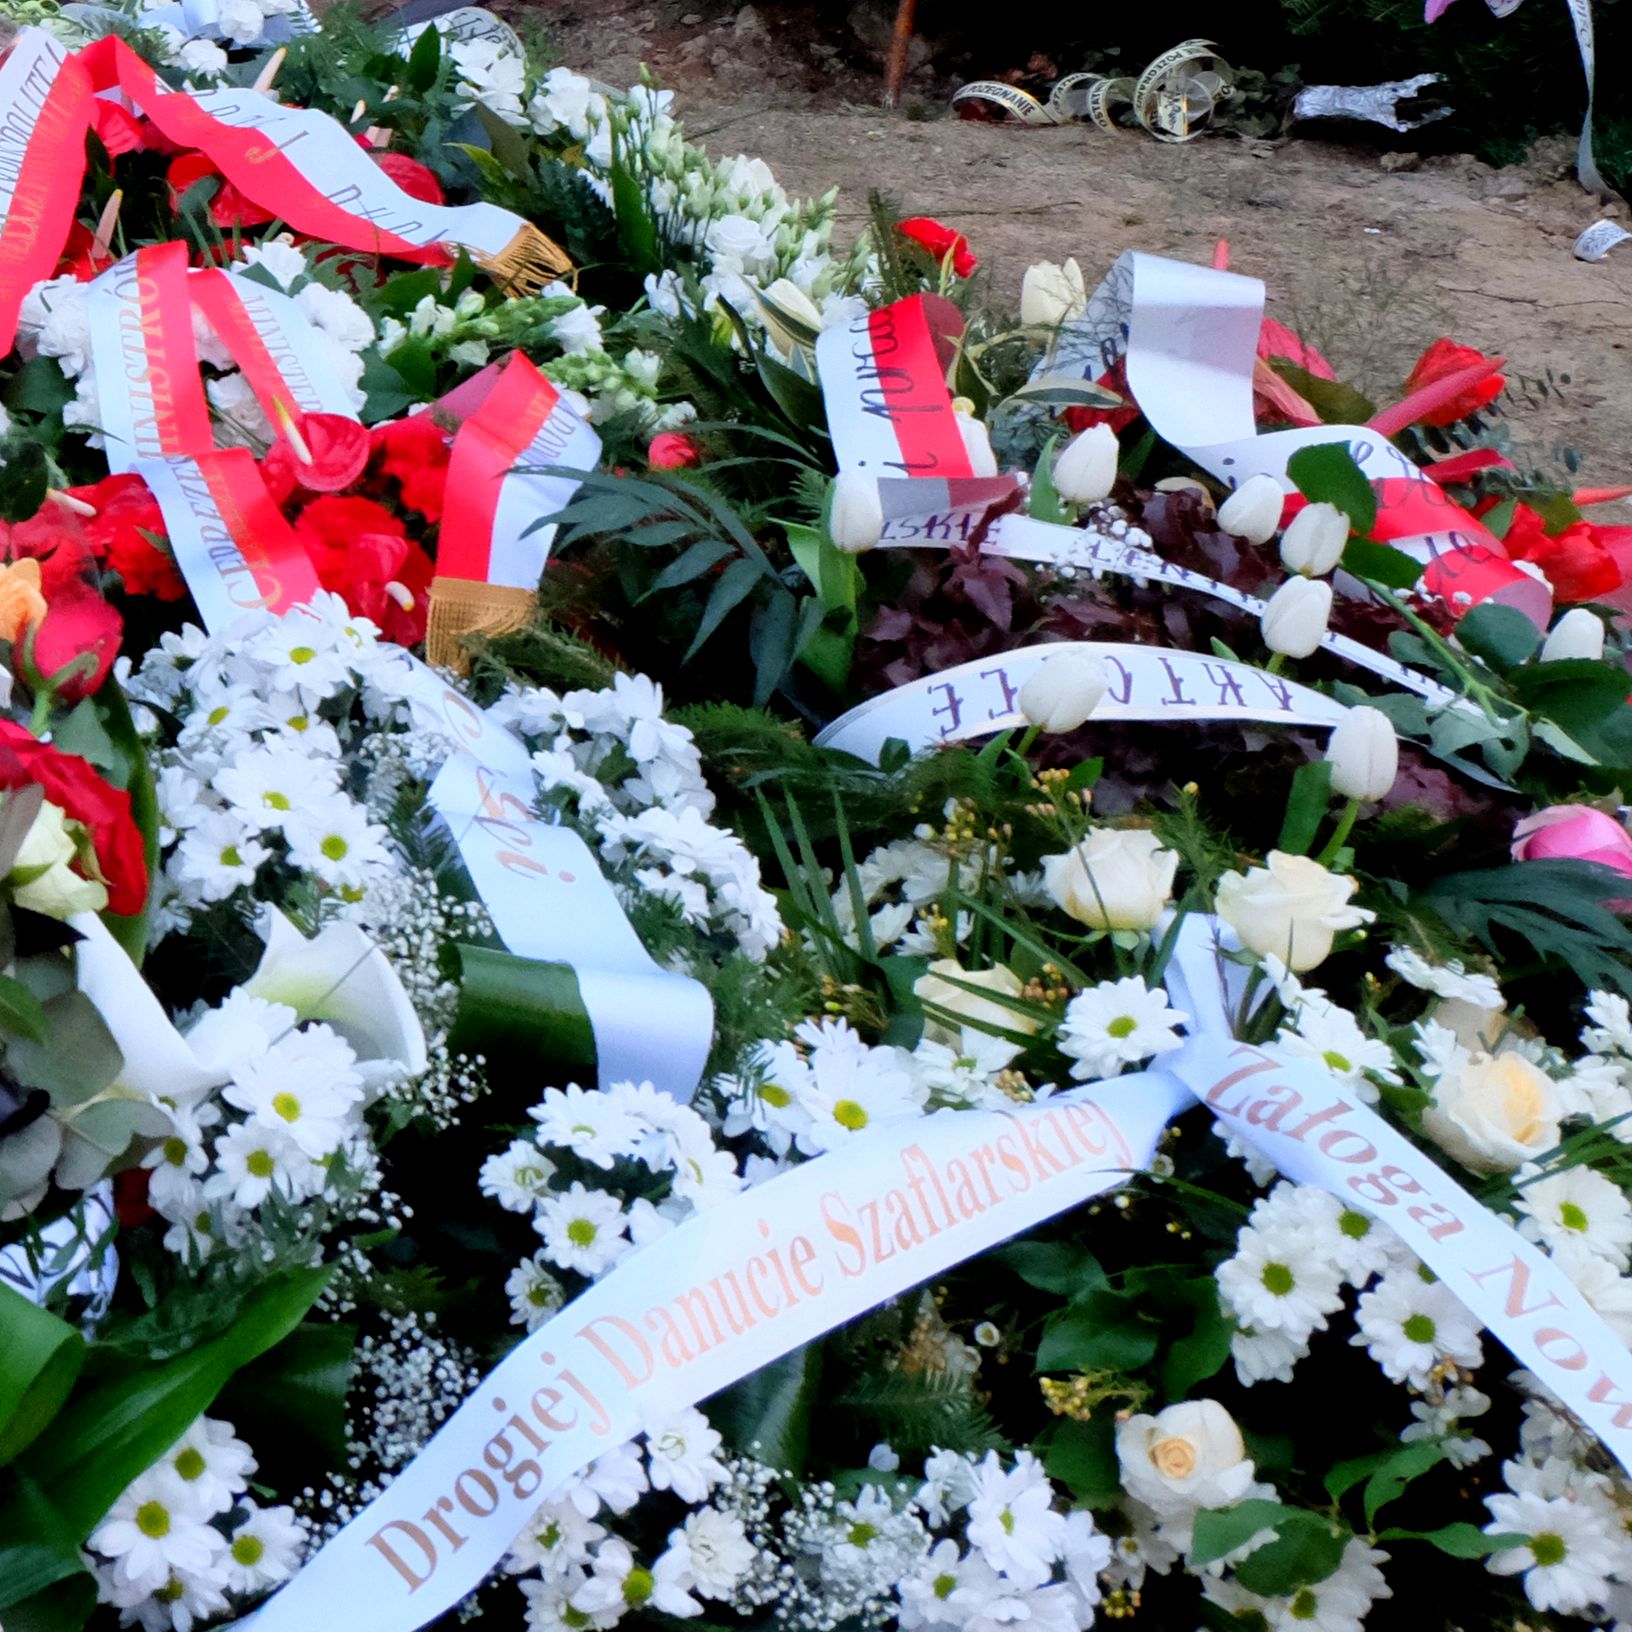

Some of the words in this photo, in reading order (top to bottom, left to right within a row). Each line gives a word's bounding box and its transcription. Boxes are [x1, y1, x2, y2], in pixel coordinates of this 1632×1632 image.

[1201, 1042, 1470, 1250] Załoga
[365, 1344, 616, 1597] Drogiej
[577, 1235, 827, 1392] Danucie
[819, 1091, 1134, 1279] Szaflarskiej
